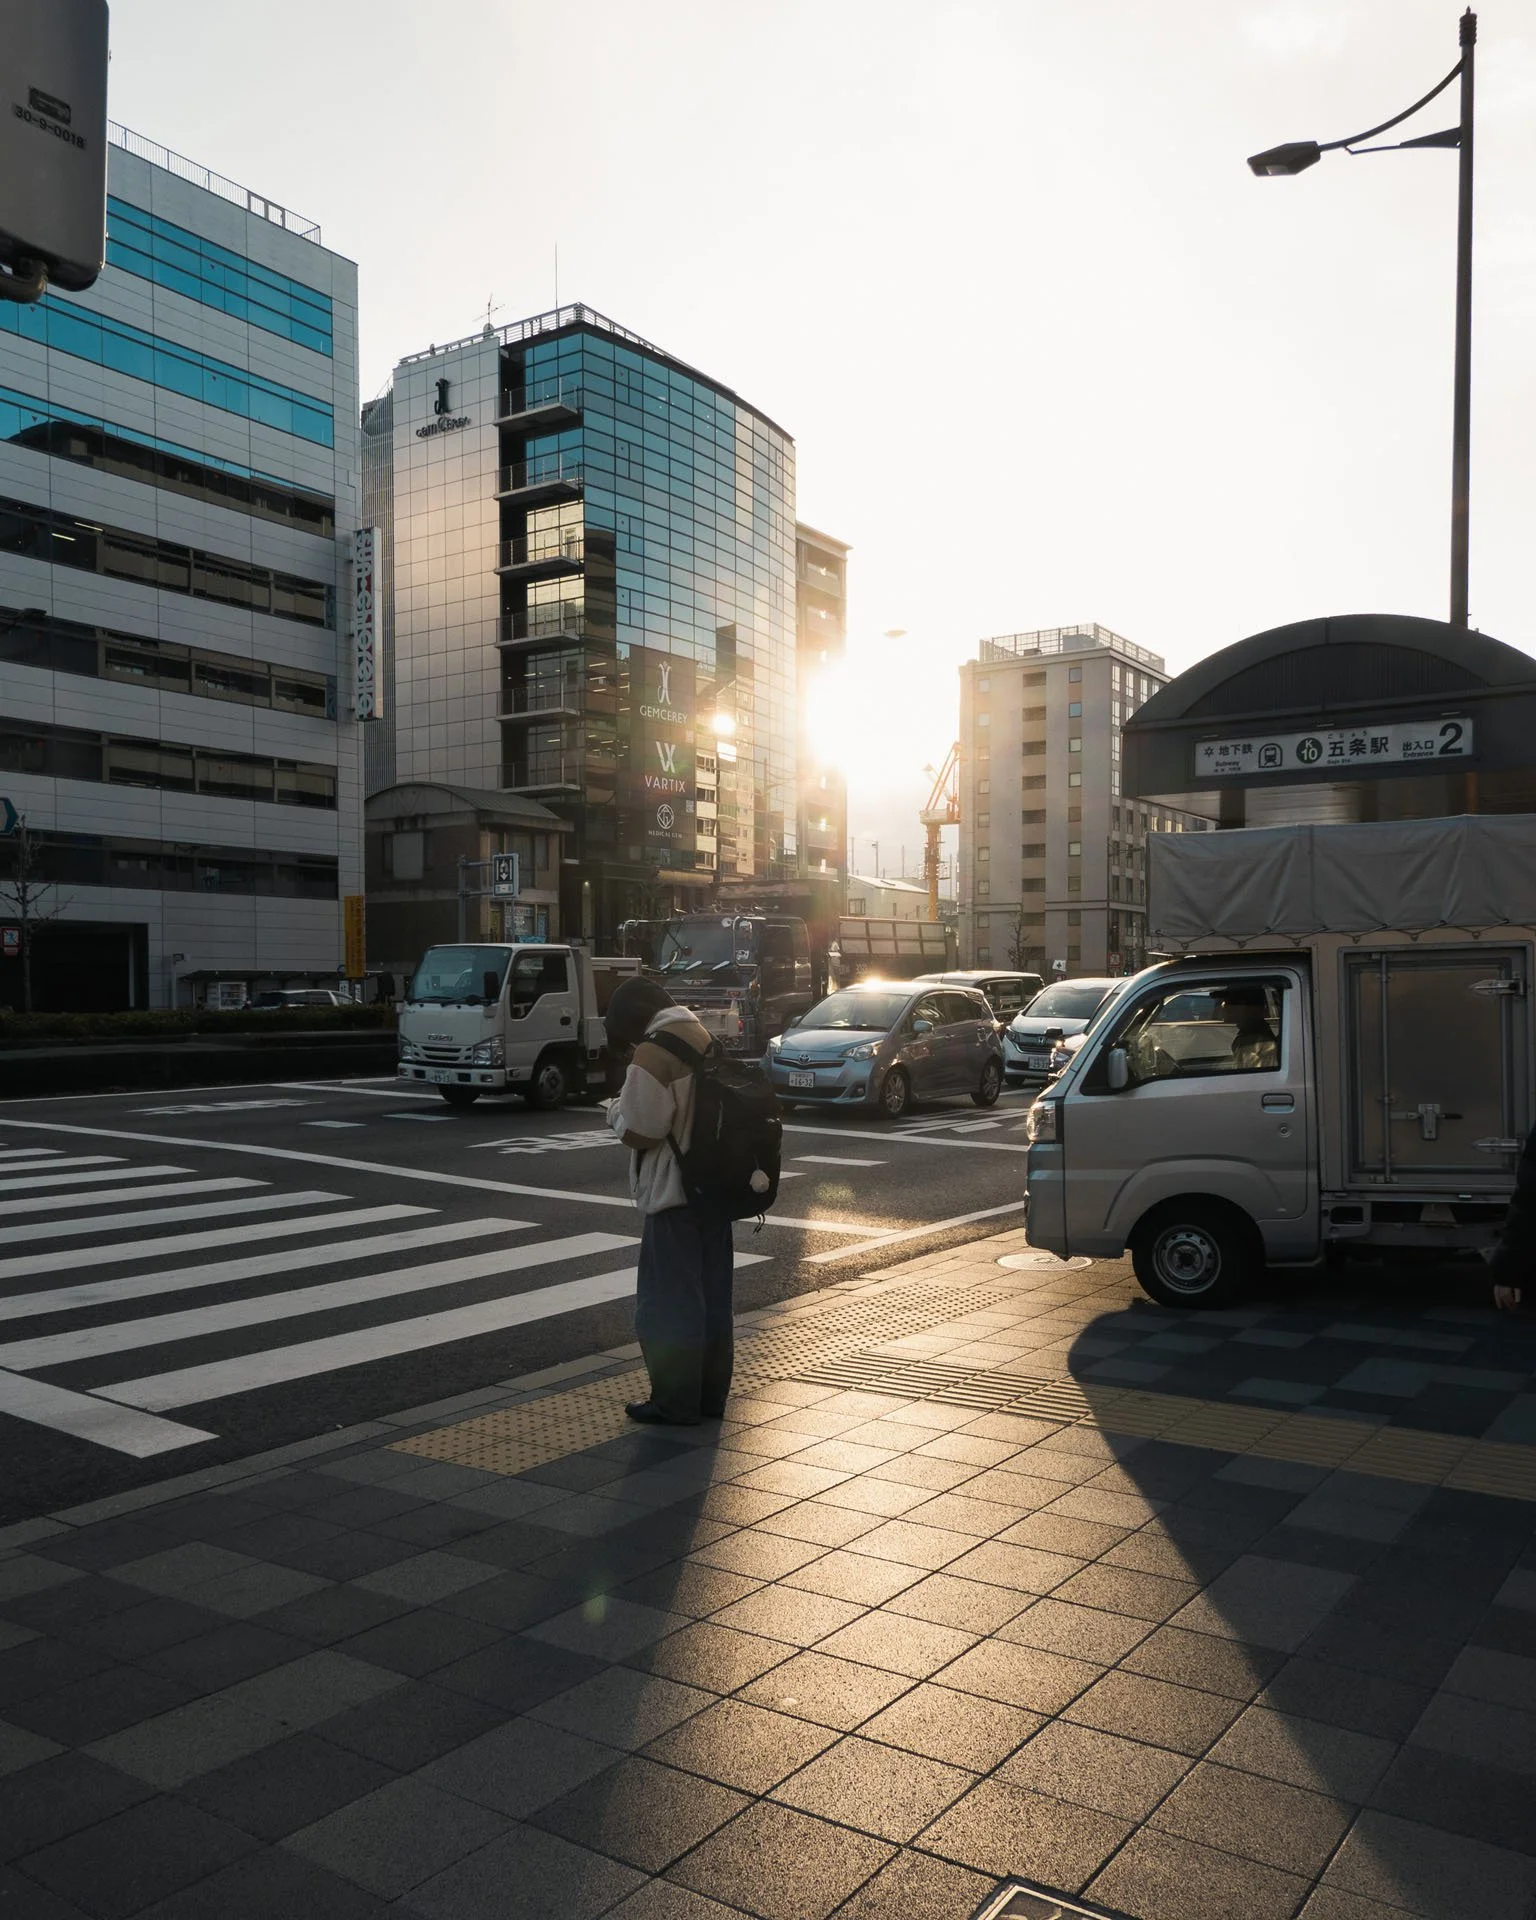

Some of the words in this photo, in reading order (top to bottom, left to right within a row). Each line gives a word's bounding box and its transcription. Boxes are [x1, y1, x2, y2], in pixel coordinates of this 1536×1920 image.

[639, 704, 688, 725] GEMCEREY
[1305, 740, 1313, 748] K
[1328, 736, 1389, 757] 五条駅
[1402, 740, 1434, 751] 出入口
[1438, 722, 1464, 755] 2
[1218, 743, 1253, 756] 地下鉄
[1301, 747, 1319, 761] 10
[644, 775, 687, 793] VARTIX
